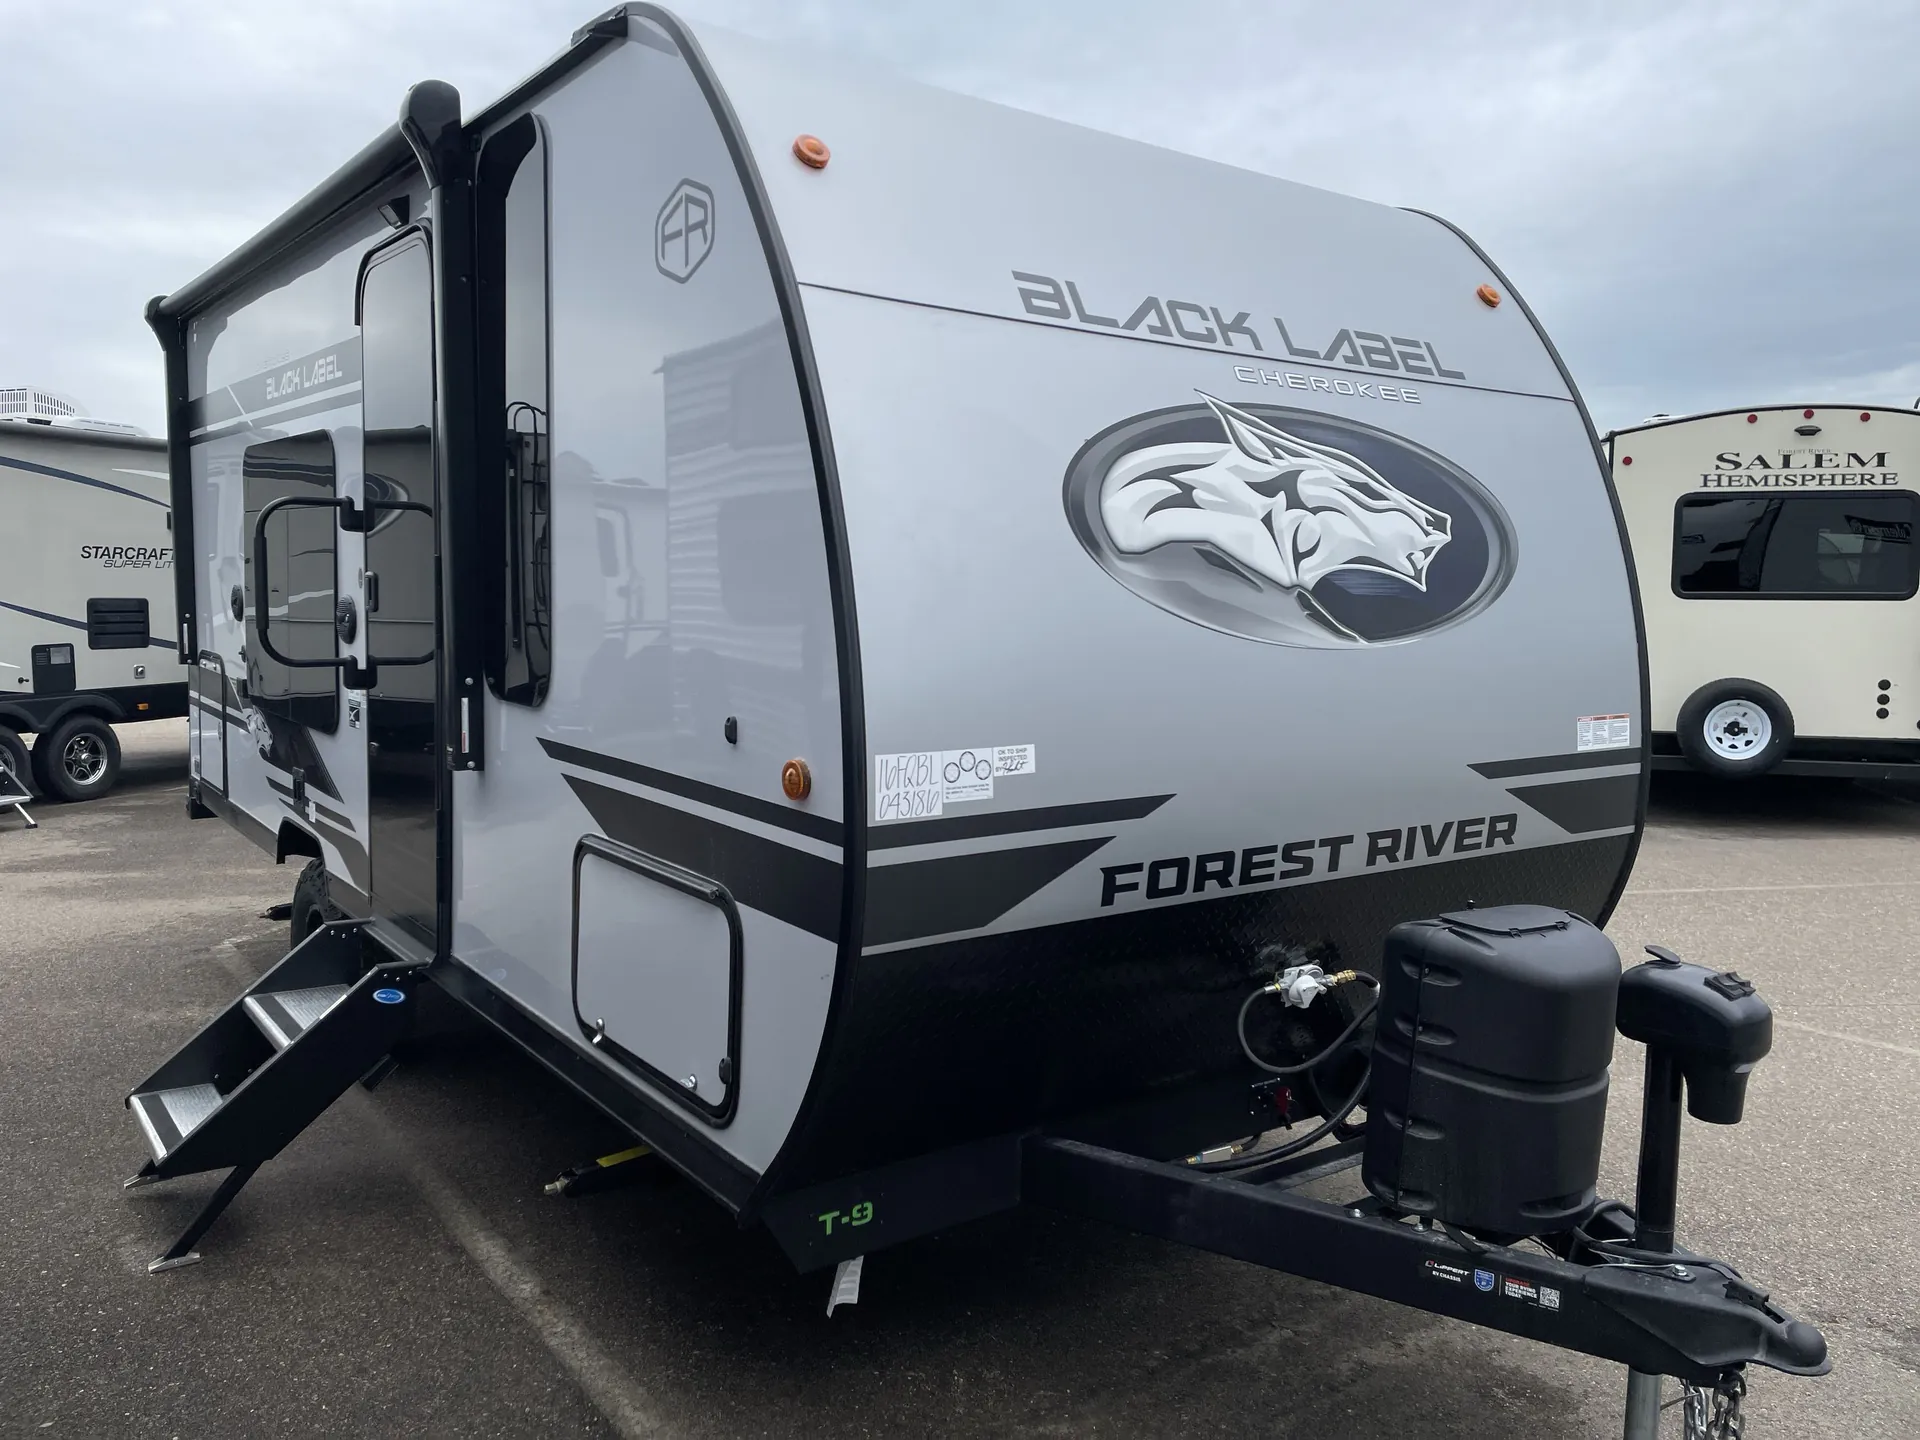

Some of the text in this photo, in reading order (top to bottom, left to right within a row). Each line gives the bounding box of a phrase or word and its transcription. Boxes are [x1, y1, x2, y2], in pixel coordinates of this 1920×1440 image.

[1011, 269, 1467, 380] BLACK LABEL
[265, 366, 301, 401] BLACK
[302, 353, 343, 389] LABEL
[1232, 364, 1422, 405] CHEROKEE
[1699, 472, 1900, 488] HEMISPHERE
[1714, 451, 1891, 471] SALEM
[103, 559, 174, 569] SUPER LIT
[1099, 812, 1518, 908] FOREST RIVER
[818, 1200, 874, 1236] T-9
